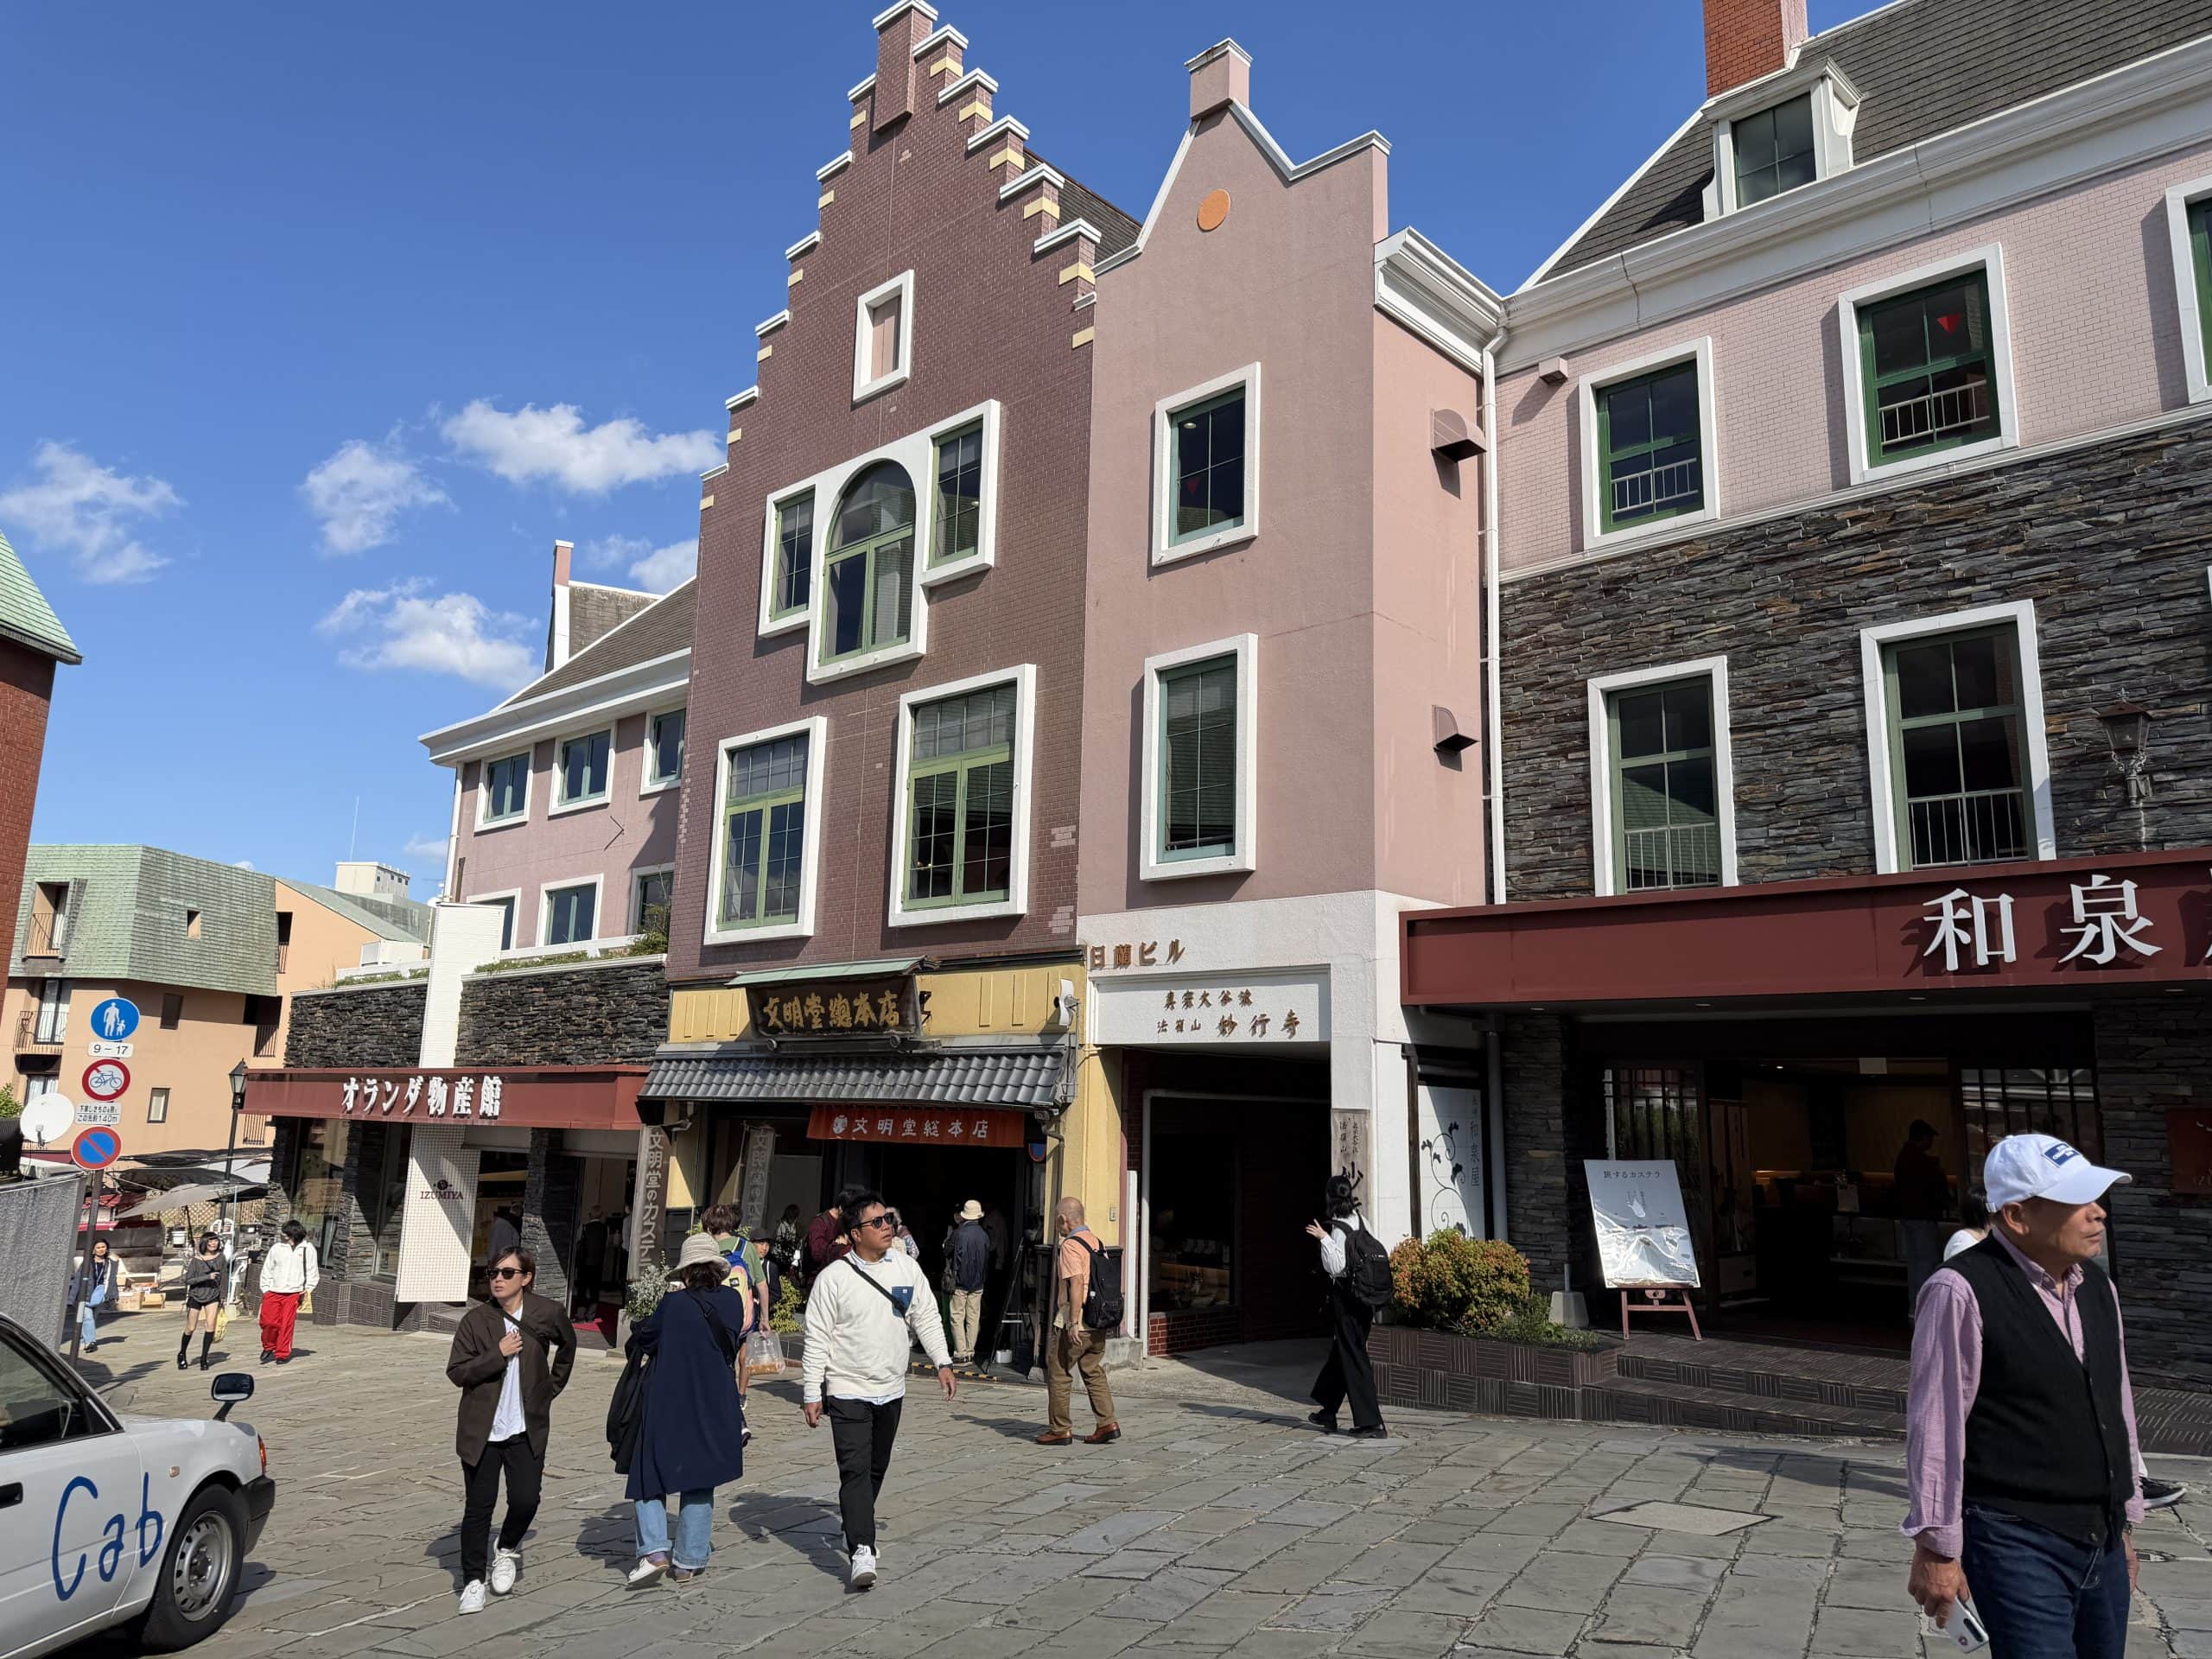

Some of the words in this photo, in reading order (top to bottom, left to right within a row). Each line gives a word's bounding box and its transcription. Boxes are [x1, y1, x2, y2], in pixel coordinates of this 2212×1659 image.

[1922, 869, 2212, 971] 和泉
[1090, 939, 1185, 969] 日蘭ビル
[1164, 988, 1253, 1010] 真宗大谷派
[1217, 1009, 1300, 1039] 妙行寺
[341, 1076, 503, 1117] オランダ物産館
[852, 1117, 988, 1138] 文明堂総本店
[420, 1191, 464, 1200] IZUMIYA
[52, 1471, 163, 1601] Cab
